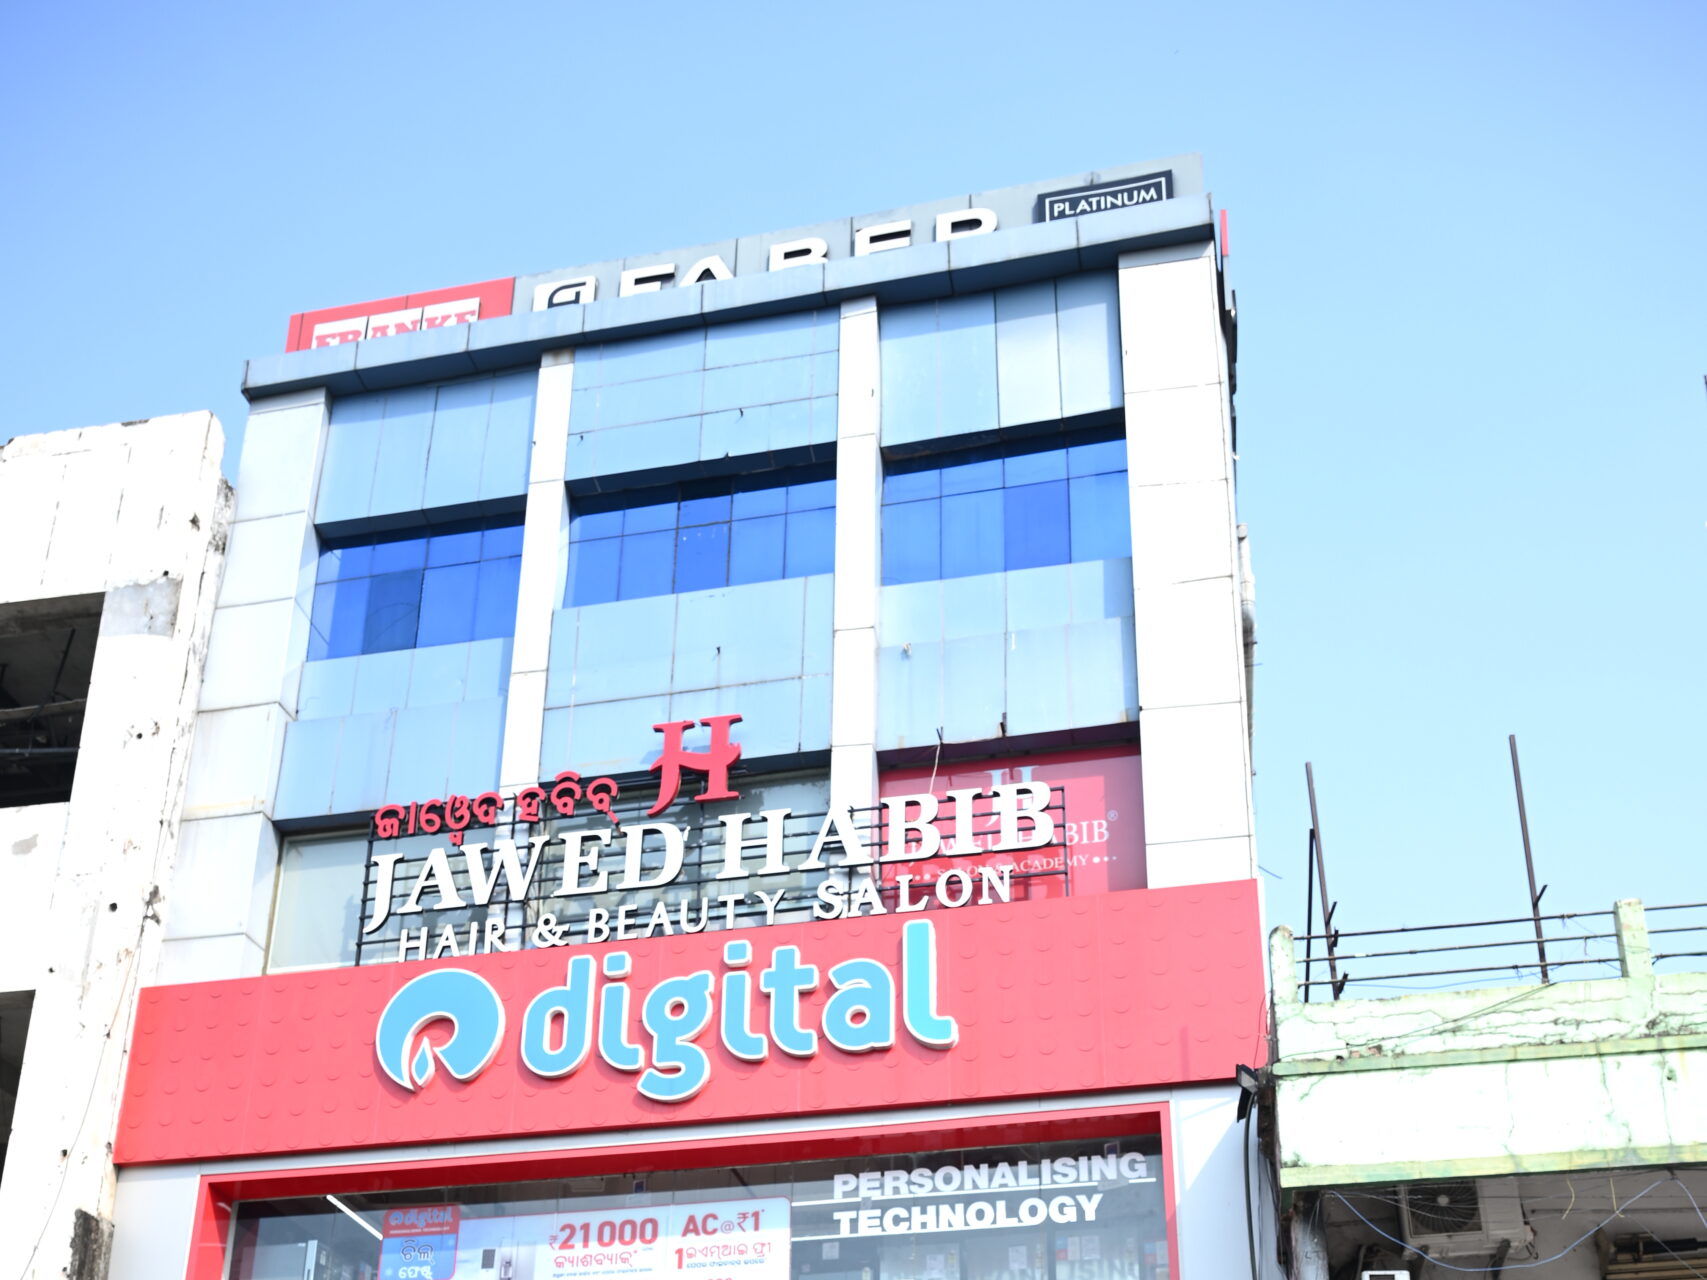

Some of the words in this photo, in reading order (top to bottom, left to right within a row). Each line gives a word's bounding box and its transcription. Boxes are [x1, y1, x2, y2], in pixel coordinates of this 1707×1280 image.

[1053, 187, 1158, 218] PLATINUM
[363, 822, 692, 933] JAWED
[715, 780, 1056, 880] HABIB
[399, 921, 519, 963] HAIR
[532, 913, 570, 948] &
[586, 887, 786, 944] BEAUTY
[812, 864, 1014, 921] SALON
[520, 918, 958, 1104] digital
[833, 1153, 1148, 1200] PERSONALISING
[833, 1193, 1104, 1236] TECHNOLOGY
